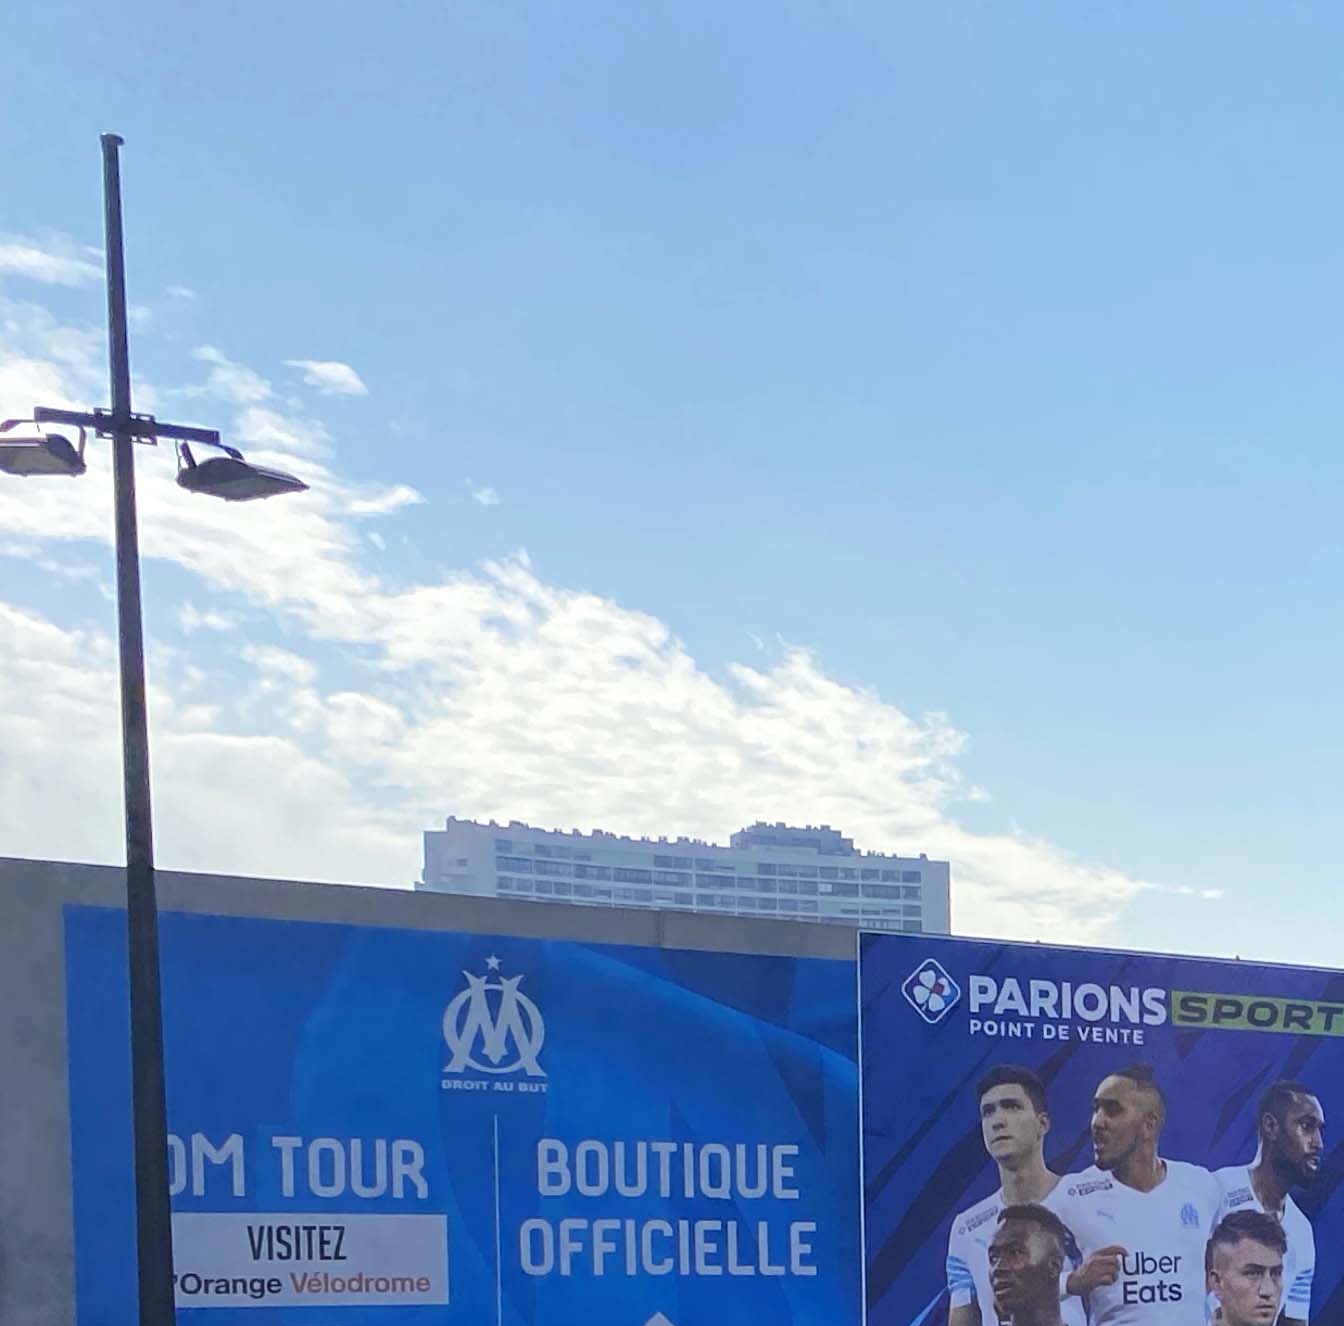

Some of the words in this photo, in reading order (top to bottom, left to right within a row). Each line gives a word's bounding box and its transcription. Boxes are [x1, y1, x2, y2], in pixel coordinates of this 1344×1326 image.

[969, 975, 1167, 1026] PARIONS
[1177, 995, 1344, 1032] SPORT
[969, 1019, 1035, 1038] POINT
[1042, 1024, 1070, 1040] DE
[1077, 1026, 1145, 1045] VENTE
[441, 1079, 489, 1090] DROIT
[493, 1081, 514, 1092] AU
[518, 1083, 548, 1093] BUT
[271, 1136, 429, 1200] TOUR
[537, 1138, 799, 1200] BOUTIQUE
[247, 1225, 347, 1261] VISITEZ
[520, 1218, 817, 1276] OFFICIELLE
[1122, 1252, 1182, 1276] Uber
[289, 1272, 432, 1294] Vélodrome
[1123, 1281, 1183, 1305] Eats
